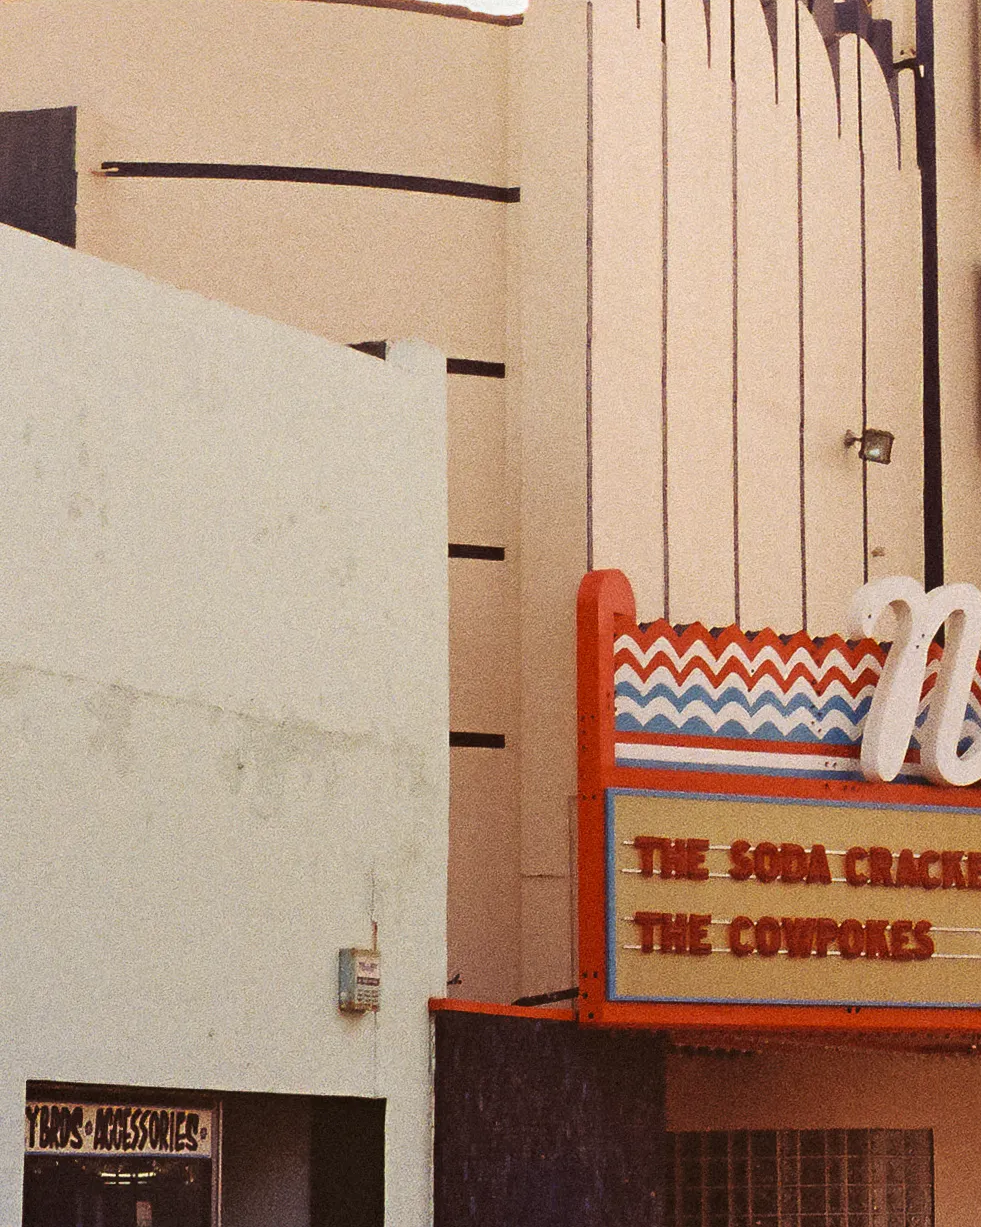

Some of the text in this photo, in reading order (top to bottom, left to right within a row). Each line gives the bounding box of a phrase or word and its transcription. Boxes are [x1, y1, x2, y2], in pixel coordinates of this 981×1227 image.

[634, 835, 710, 881] THE
[729, 839, 832, 886] SODA
[634, 911, 712, 955] THE
[729, 915, 935, 961] COWPOKES
[93, 1107, 200, 1152] ACCESSORIES
